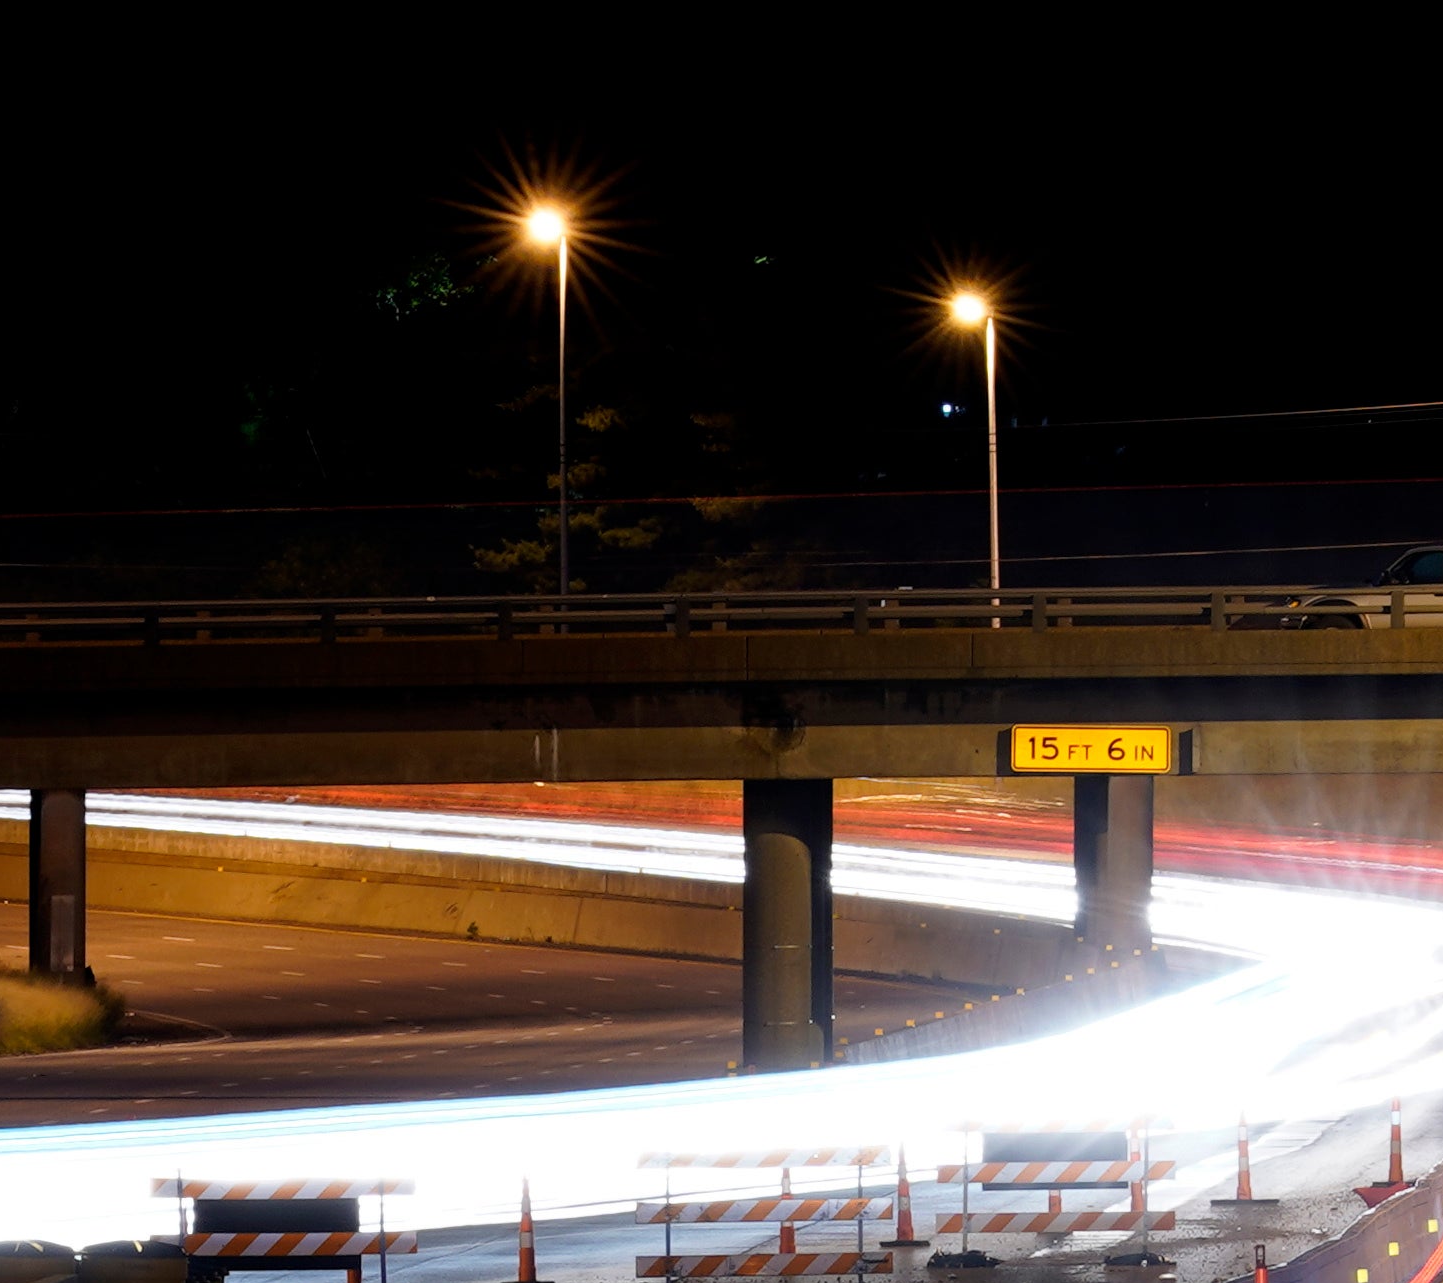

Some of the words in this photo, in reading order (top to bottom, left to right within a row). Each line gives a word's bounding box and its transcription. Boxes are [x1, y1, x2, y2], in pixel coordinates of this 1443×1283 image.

[1028, 736, 1060, 761] 15
[1067, 744, 1094, 761] FT
[1107, 737, 1126, 761] 6
[1134, 744, 1155, 762] IN
